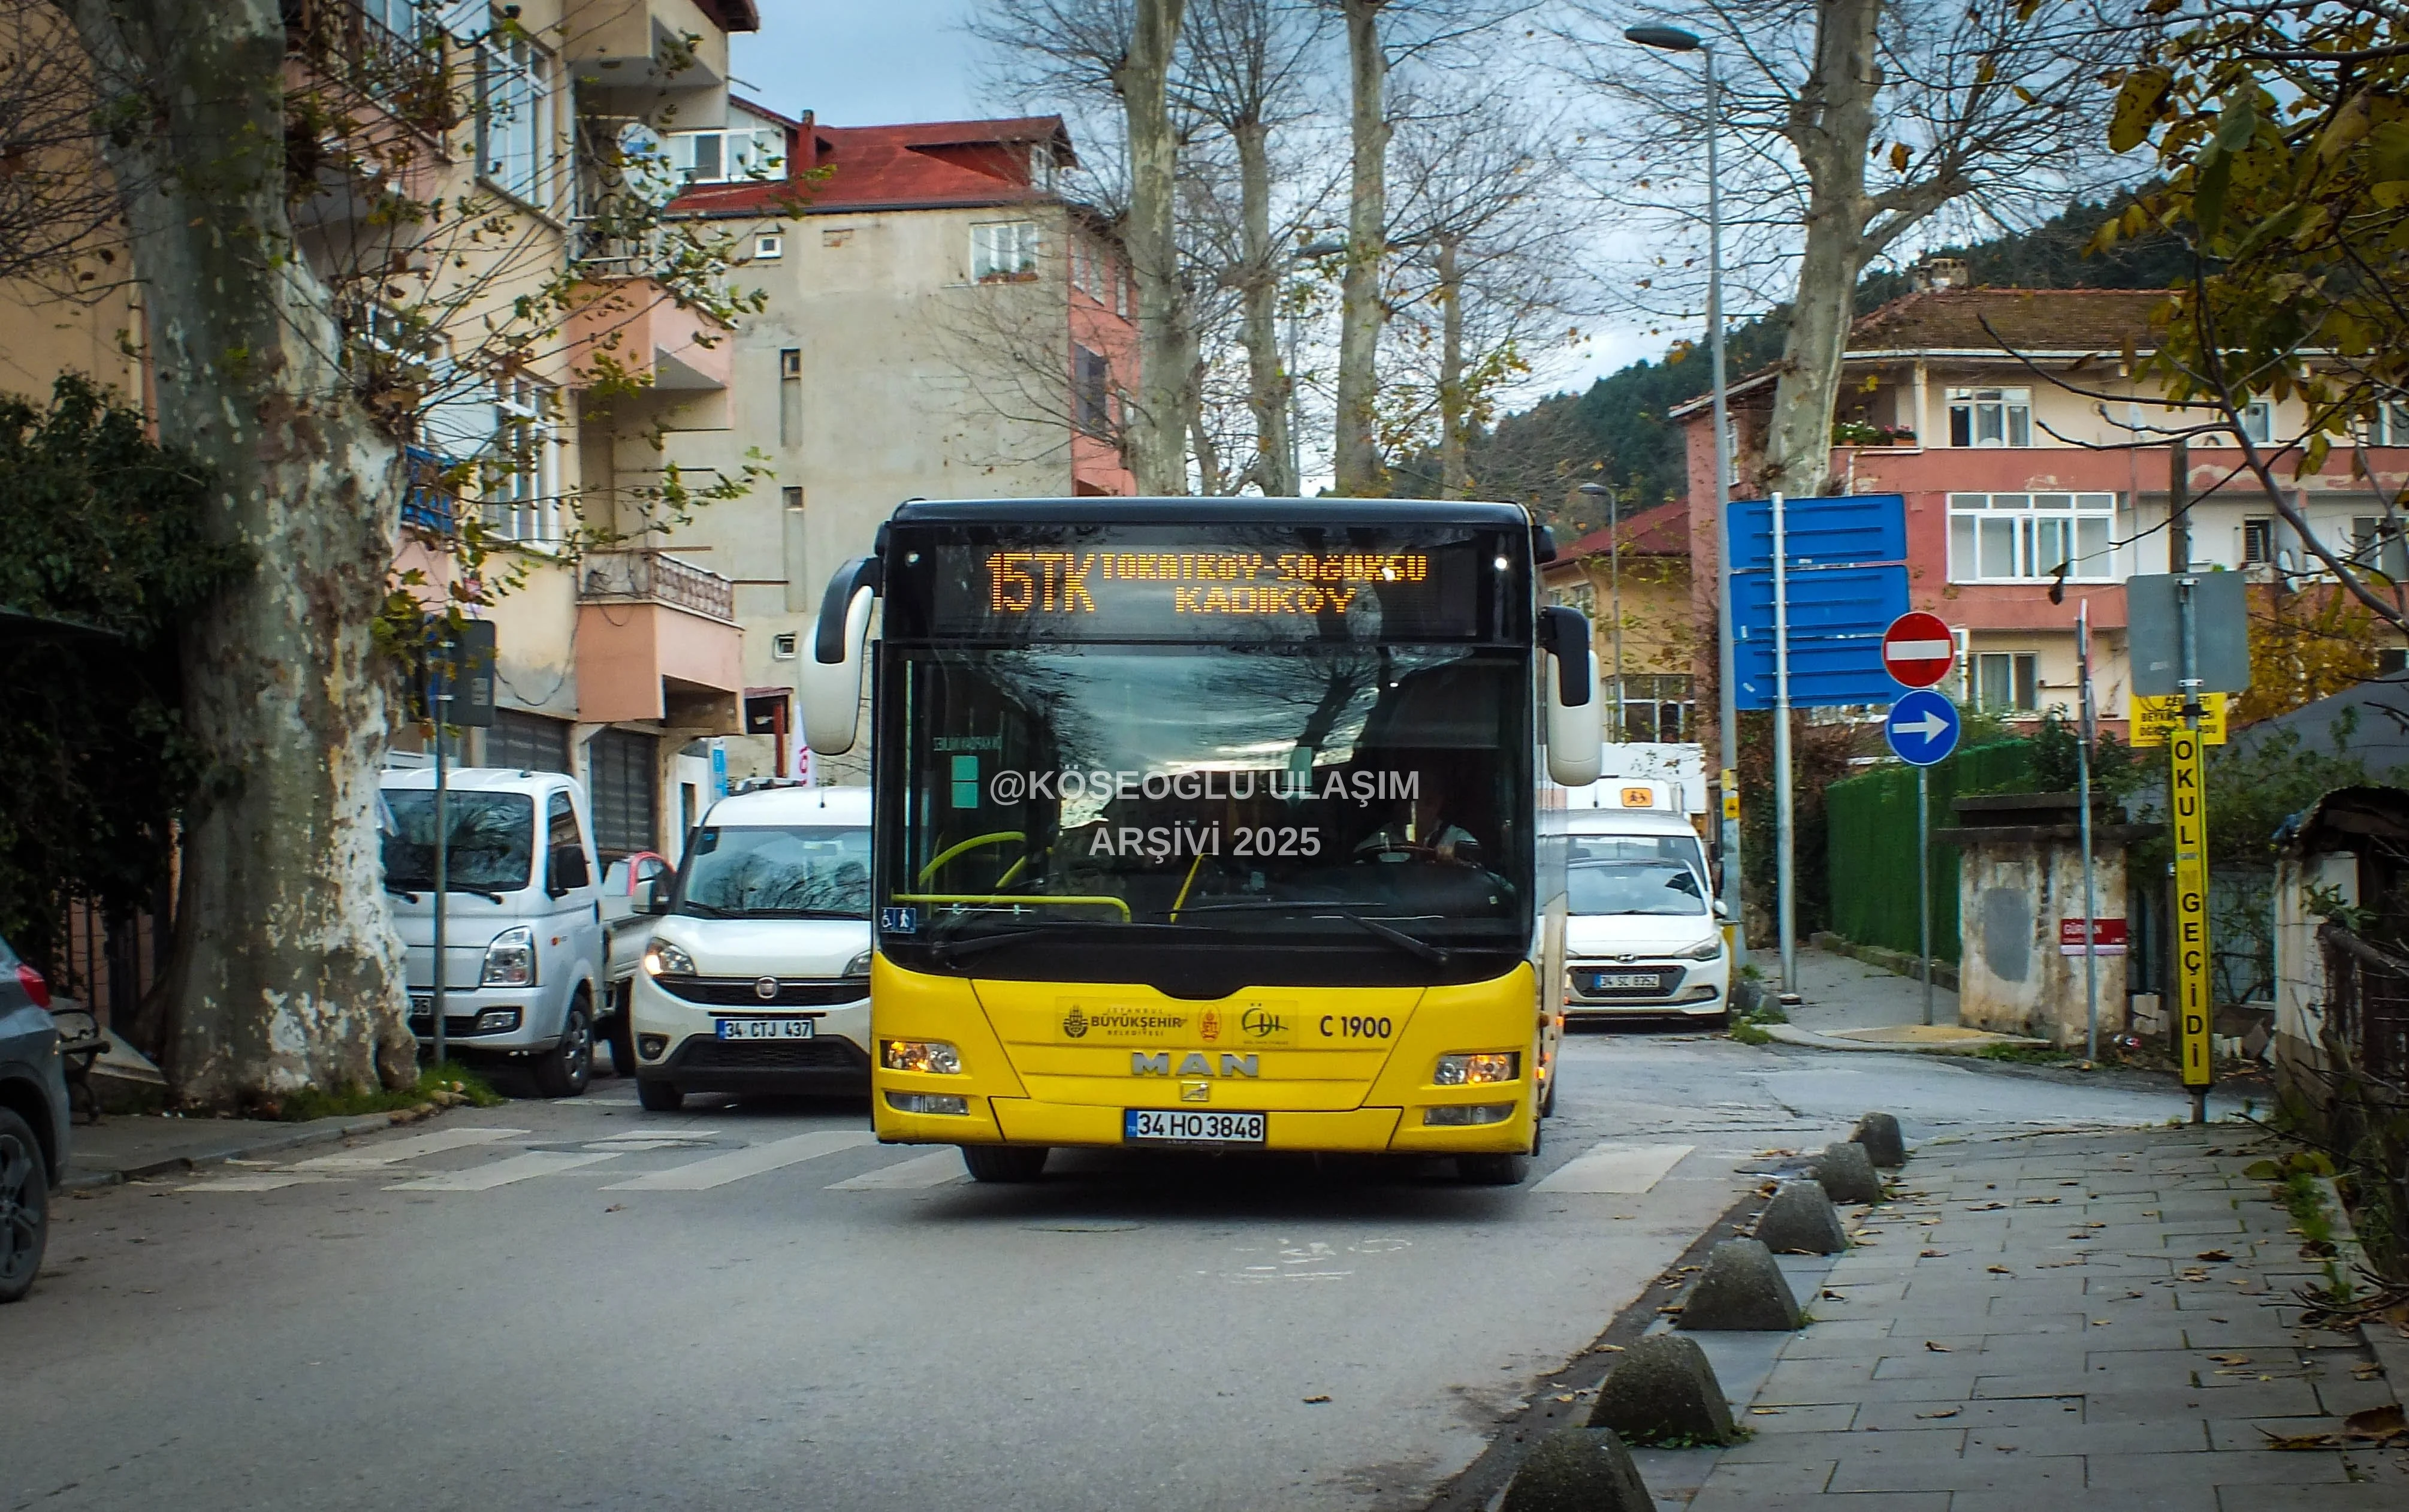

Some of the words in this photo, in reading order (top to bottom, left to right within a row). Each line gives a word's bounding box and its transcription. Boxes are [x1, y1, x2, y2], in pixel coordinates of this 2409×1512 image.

[986, 553, 1095, 612] 15TK
[1176, 586, 1356, 613] KADIKÖY
[2174, 740, 2194, 845] OKUL
[2182, 892, 2203, 1069] GEÇİDİ
[726, 1022, 742, 1037] 34
[751, 1022, 776, 1037] CTJ
[785, 1021, 810, 1037] 437
[1091, 1013, 1182, 1030] BÜYÜKŞEHİR
[1320, 1015, 1333, 1037] C
[1340, 1016, 1391, 1039] 1900
[1132, 1050, 1259, 1077] MAN
[1139, 1113, 1164, 1136] 34
[1170, 1115, 1202, 1137] HO
[1206, 1115, 1261, 1139] 3848
